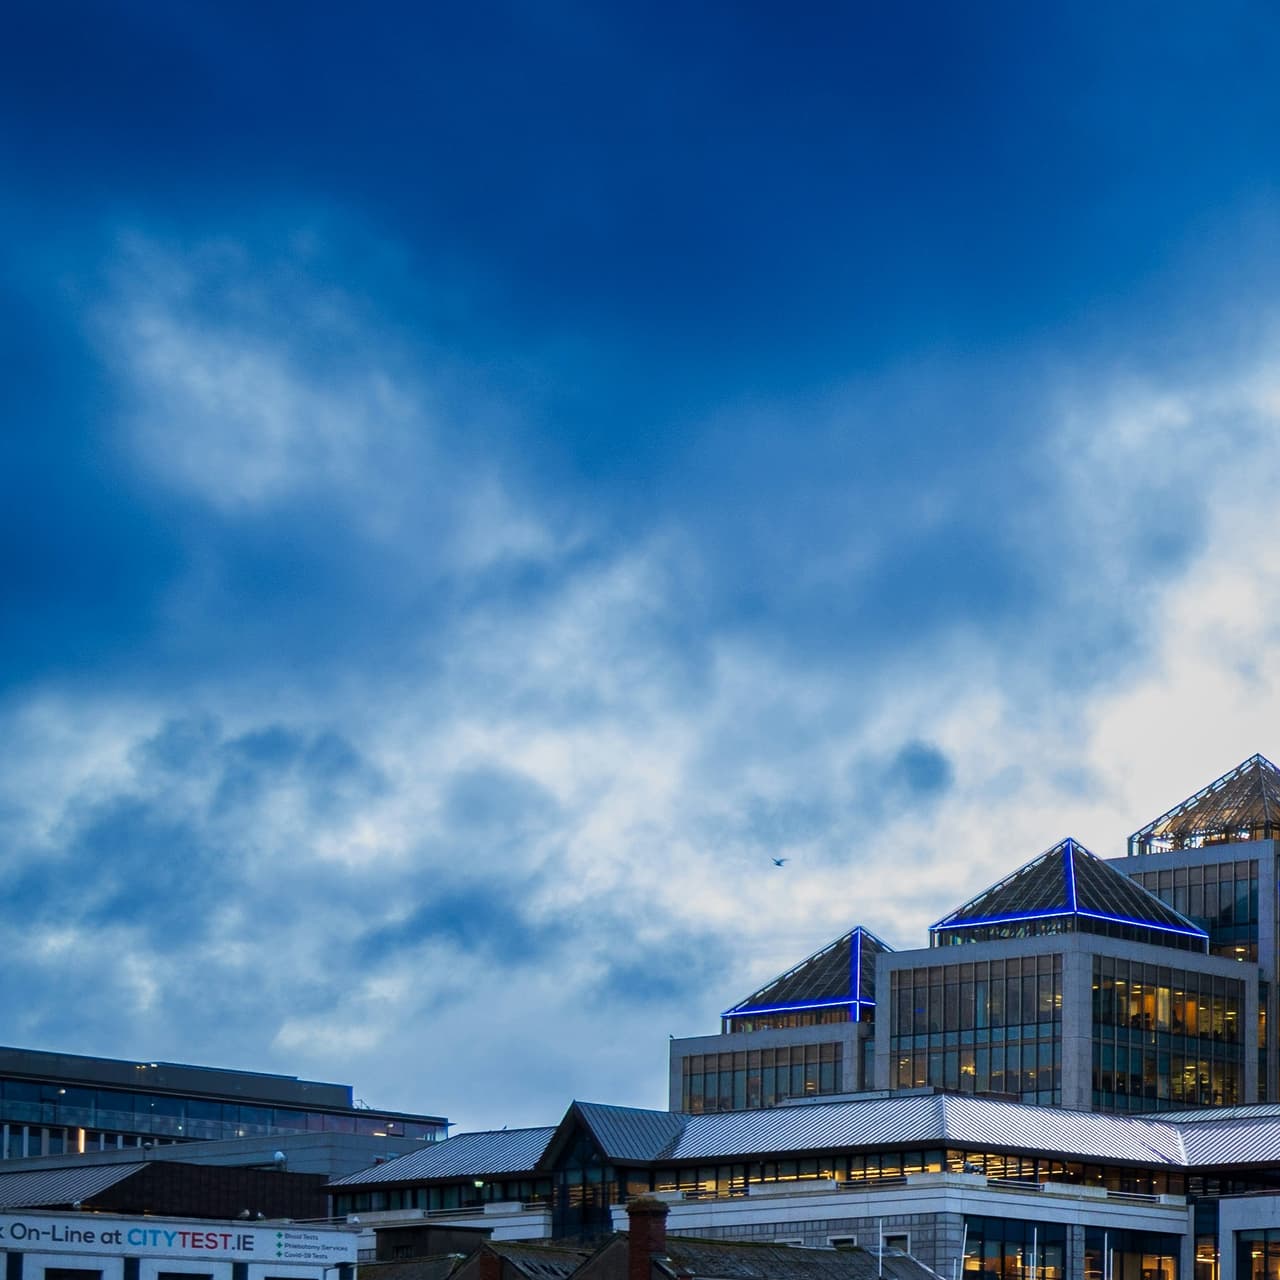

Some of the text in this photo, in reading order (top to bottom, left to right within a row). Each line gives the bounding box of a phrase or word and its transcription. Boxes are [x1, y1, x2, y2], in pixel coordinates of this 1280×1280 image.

[11, 1222, 95, 1243] On-Line
[100, 1229, 122, 1244] at
[127, 1227, 254, 1251] CITYTEST.IE
